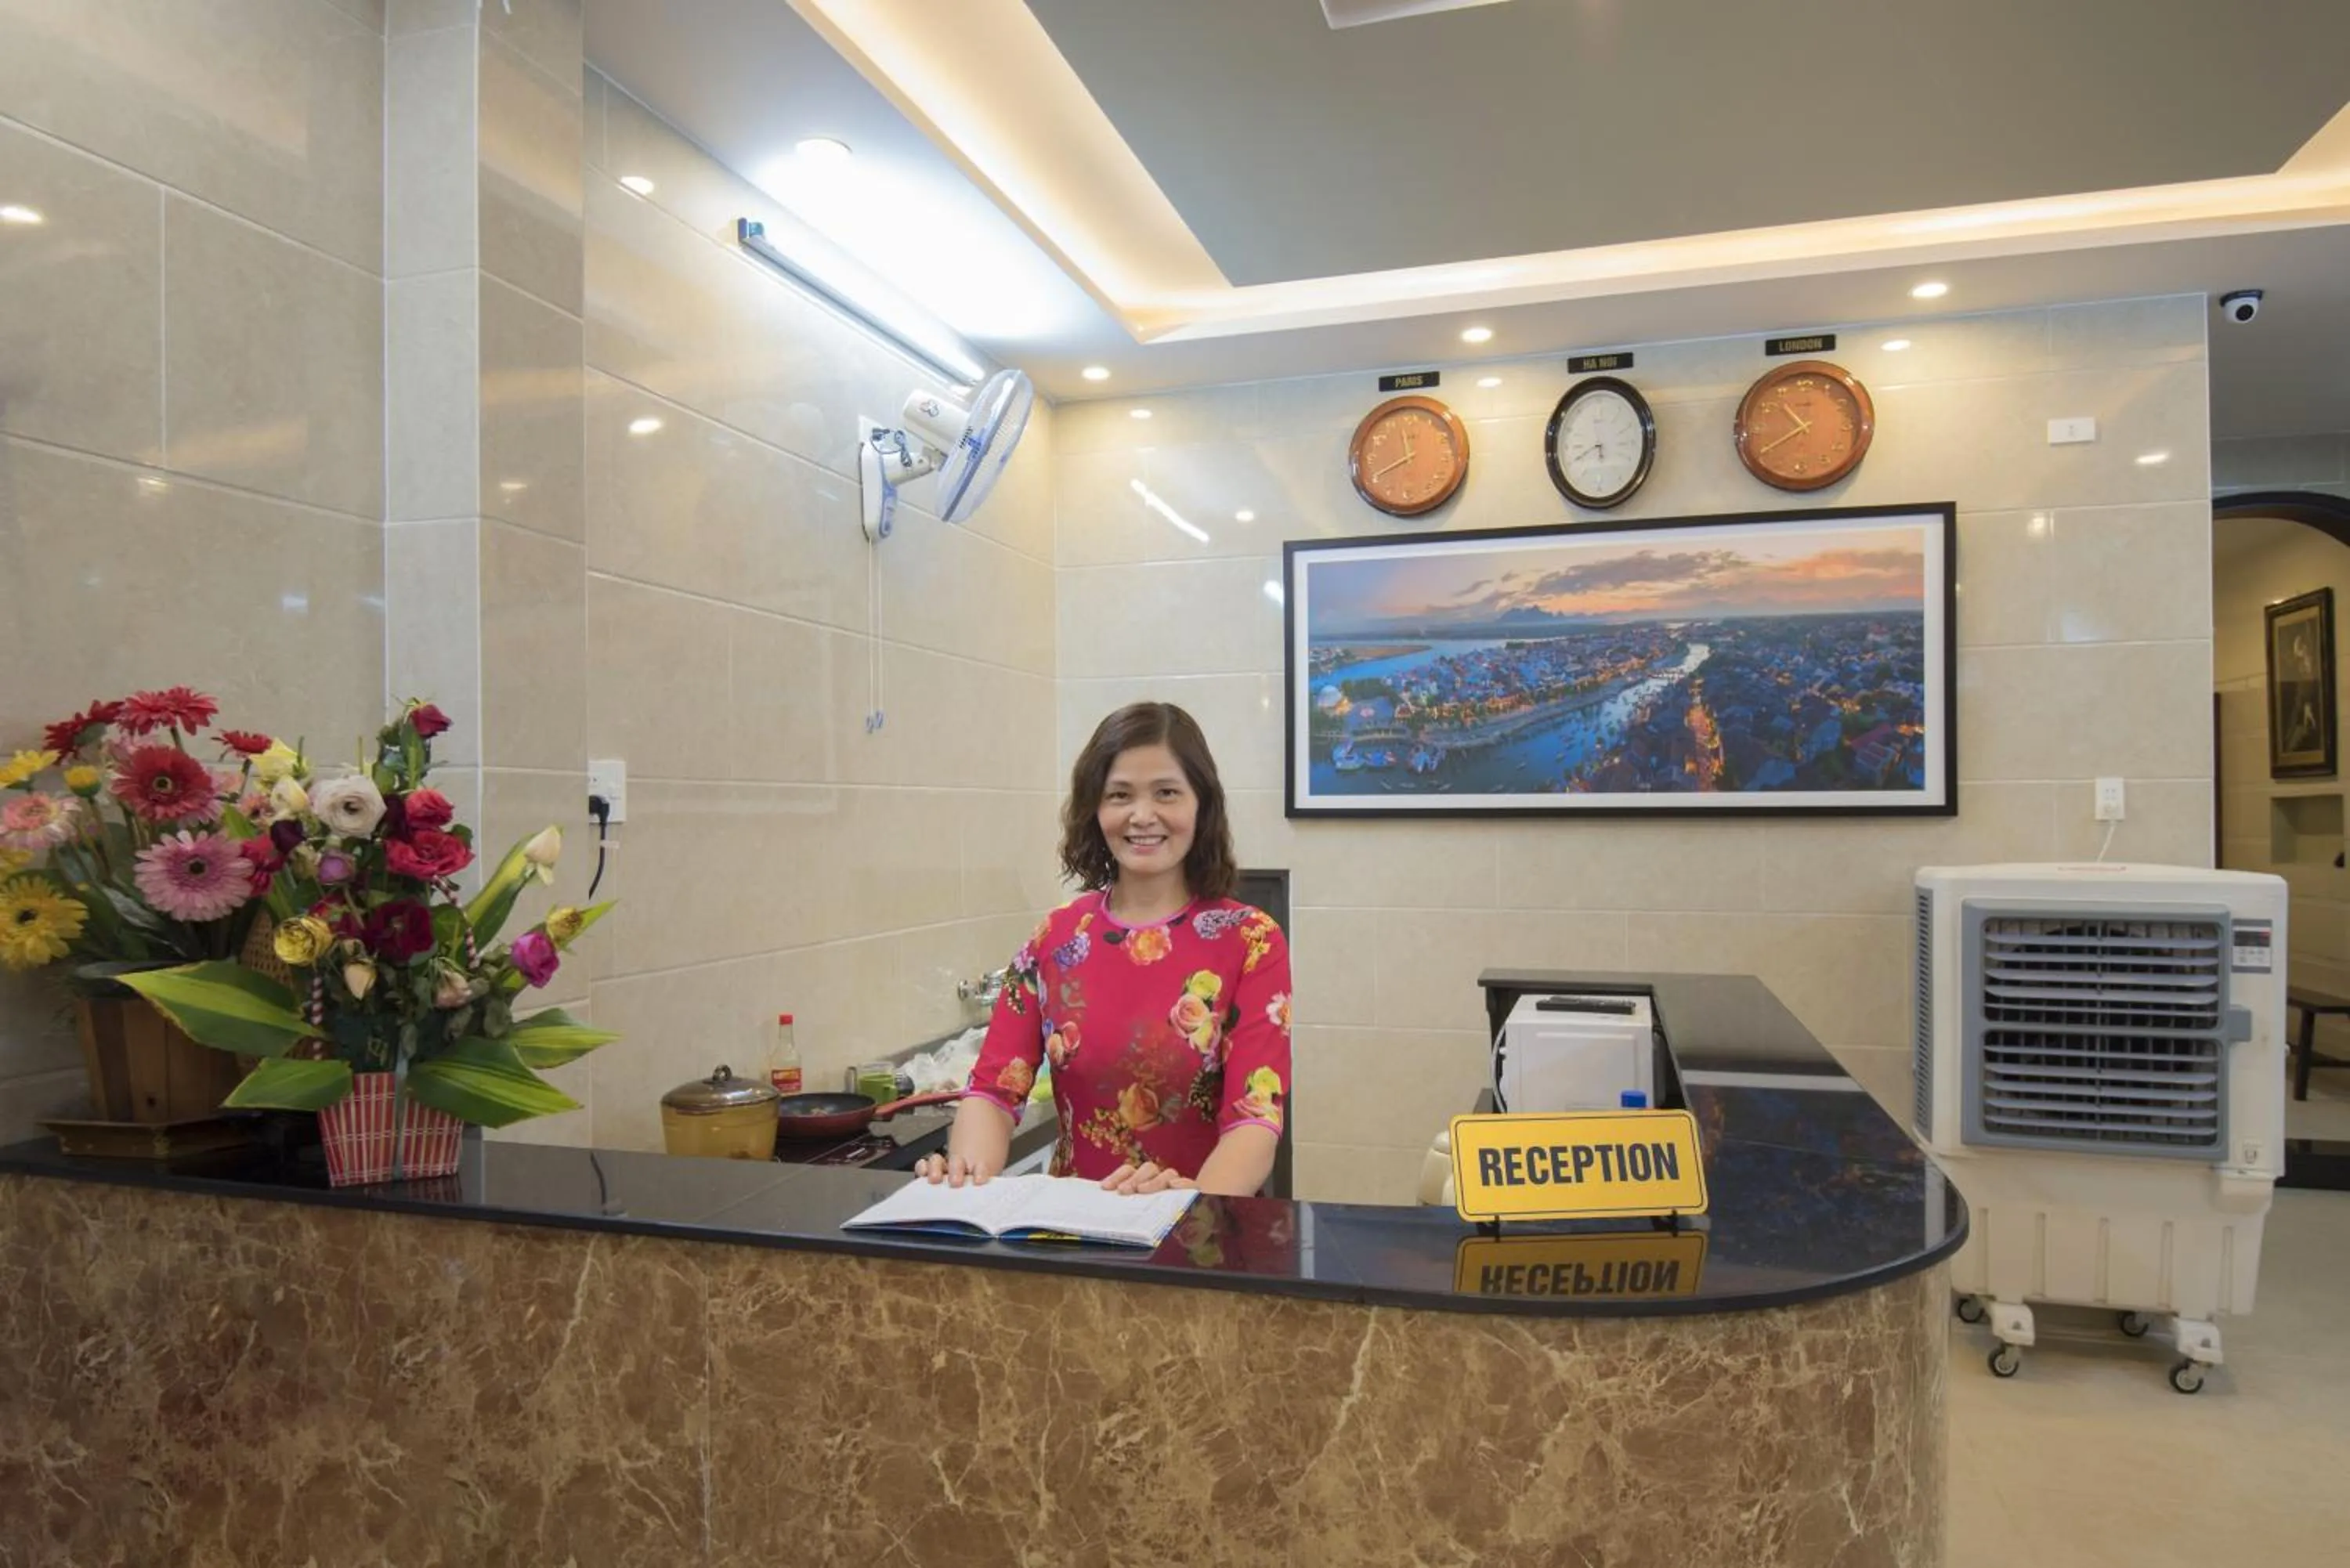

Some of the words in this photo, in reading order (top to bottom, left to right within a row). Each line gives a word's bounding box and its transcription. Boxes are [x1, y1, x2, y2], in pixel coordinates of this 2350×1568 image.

[1779, 338, 1822, 352] LONDON
[1583, 357, 1597, 370] HA
[1394, 375, 1423, 388] PARIS
[1478, 1143, 1679, 1187] RECEPTION
